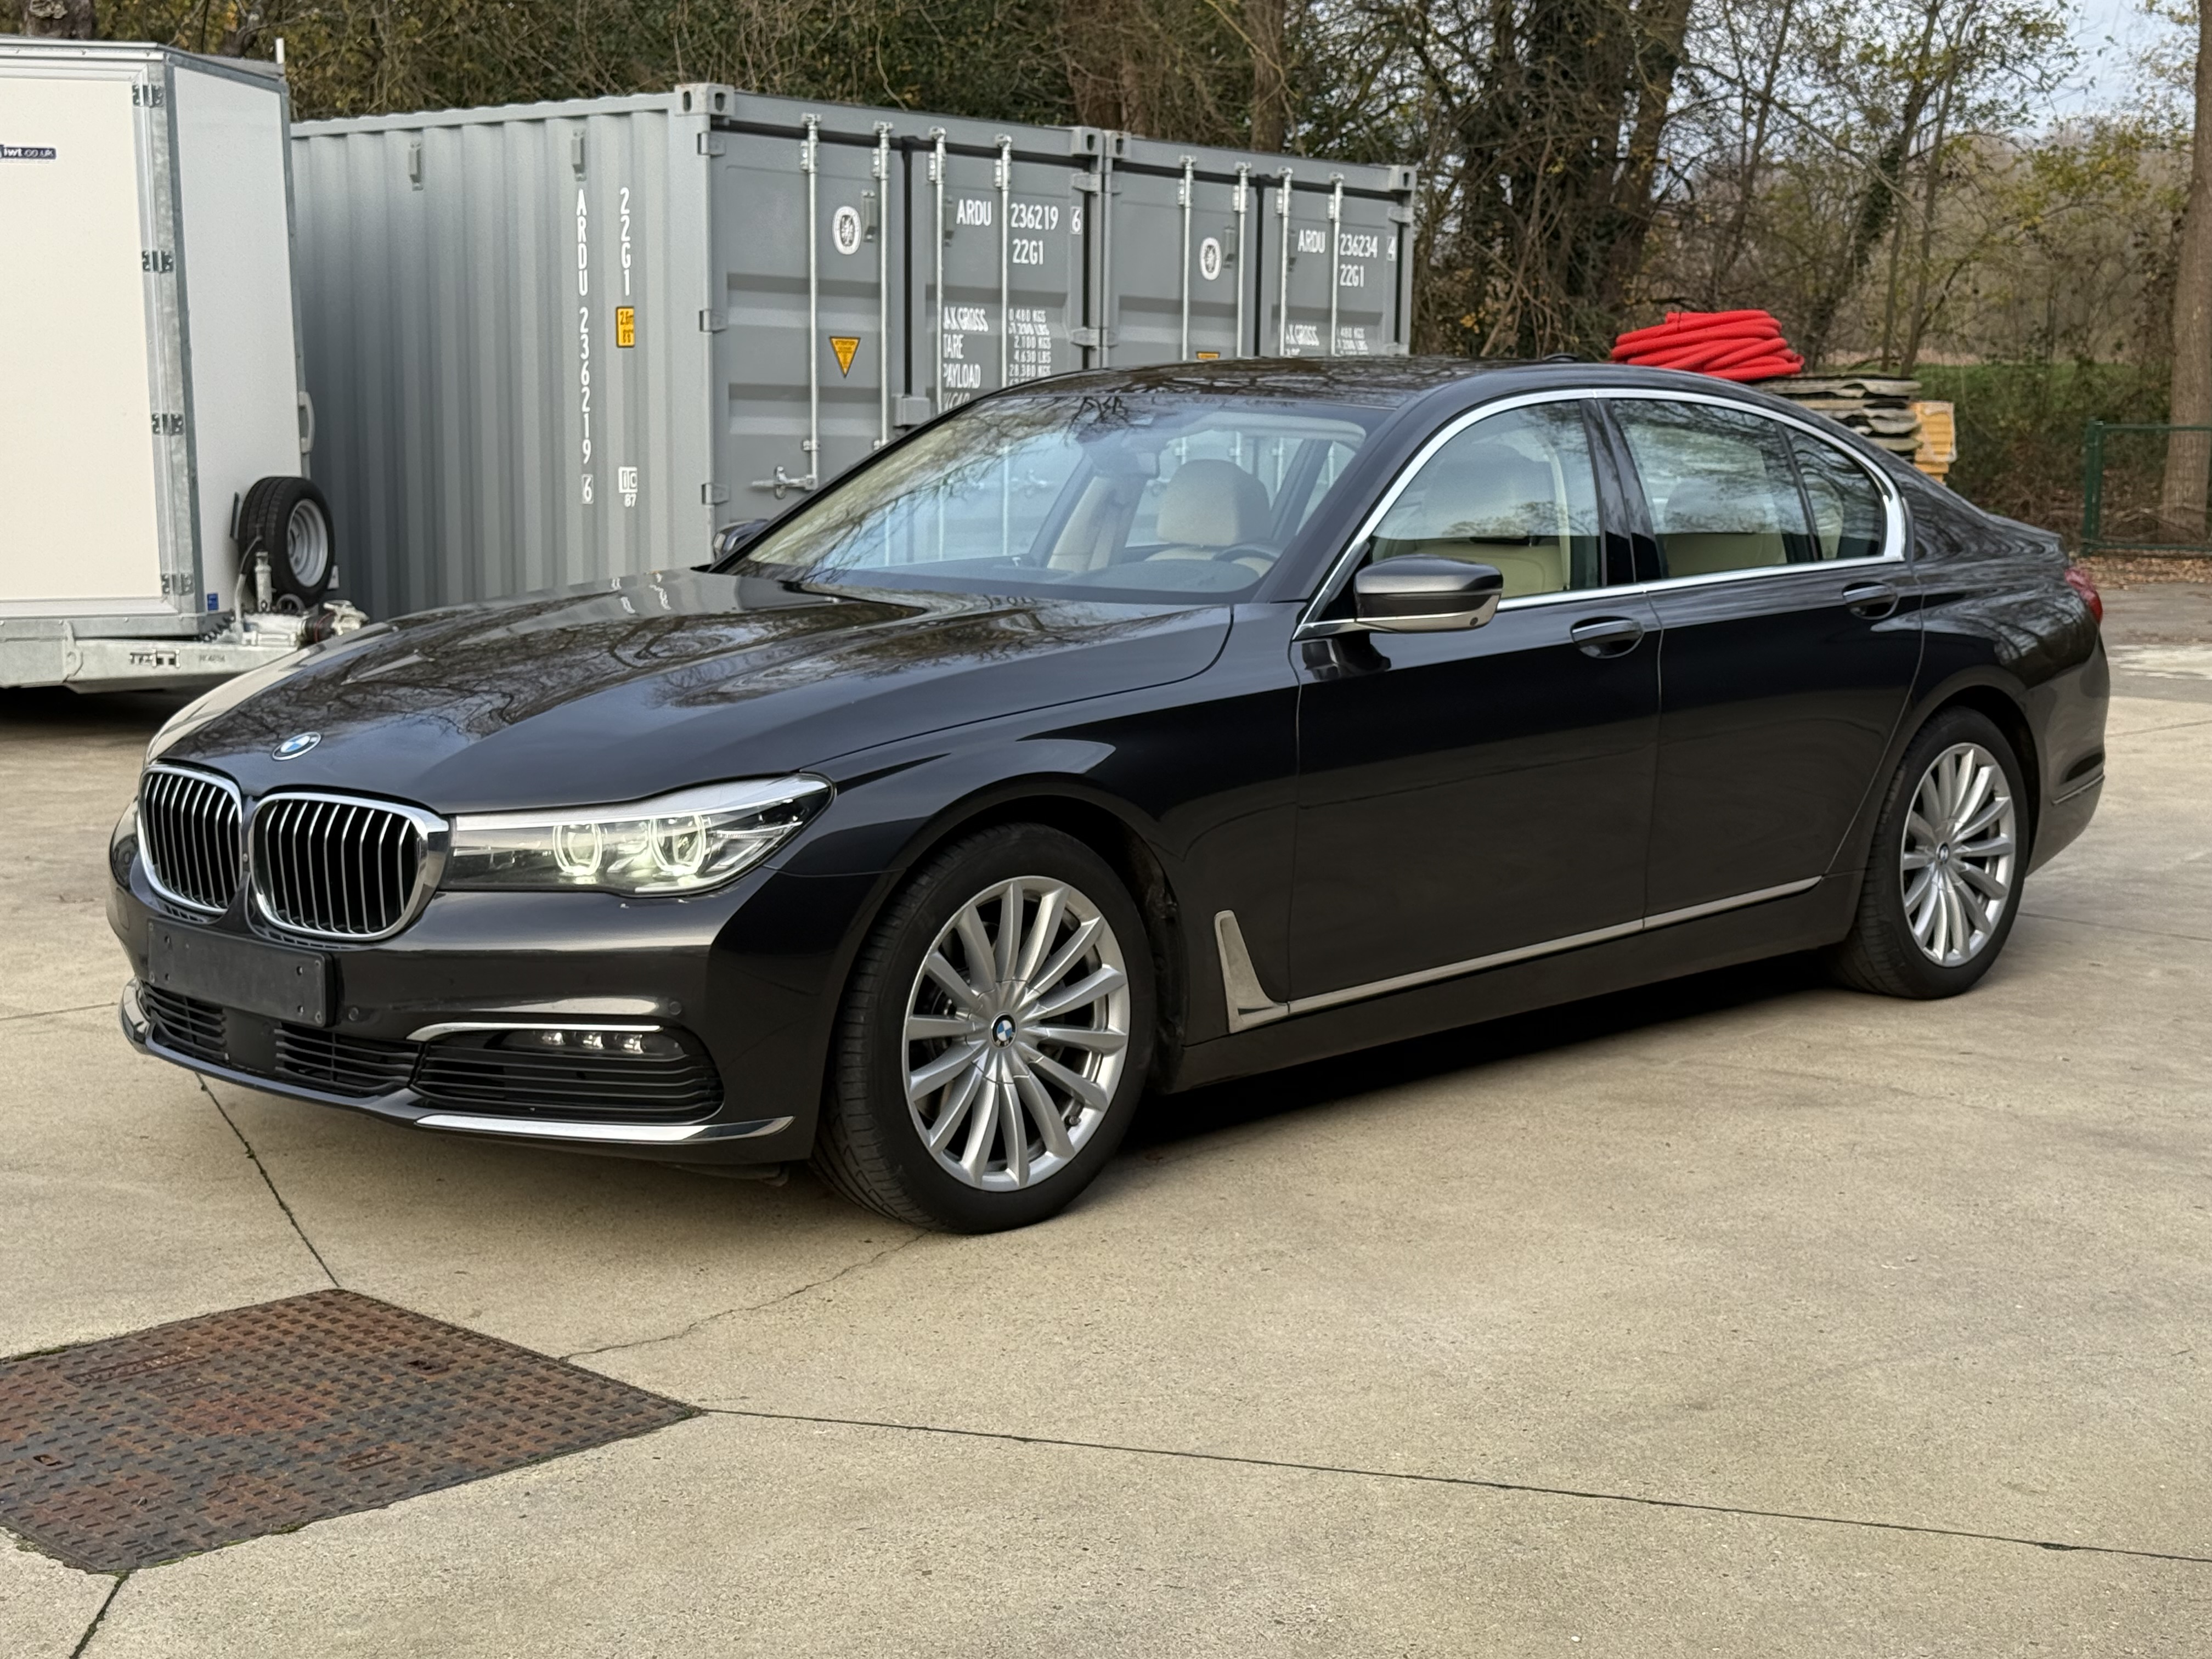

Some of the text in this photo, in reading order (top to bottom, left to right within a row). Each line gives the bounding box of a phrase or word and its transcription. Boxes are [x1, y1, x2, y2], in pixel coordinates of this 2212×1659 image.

[956, 199, 1081, 233] ARDU 236219 6
[620, 187, 631, 296] 22G1
[1012, 239, 1044, 265] 22G1
[1298, 229, 1326, 253] ARDU
[1340, 233, 1378, 258] 236234
[1340, 263, 1364, 287] 22G1
[943, 307, 960, 330] AX
[957, 307, 989, 332] GROSS
[577, 188, 592, 503] ARDU 236219 6
[624, 494, 636, 507] 87
